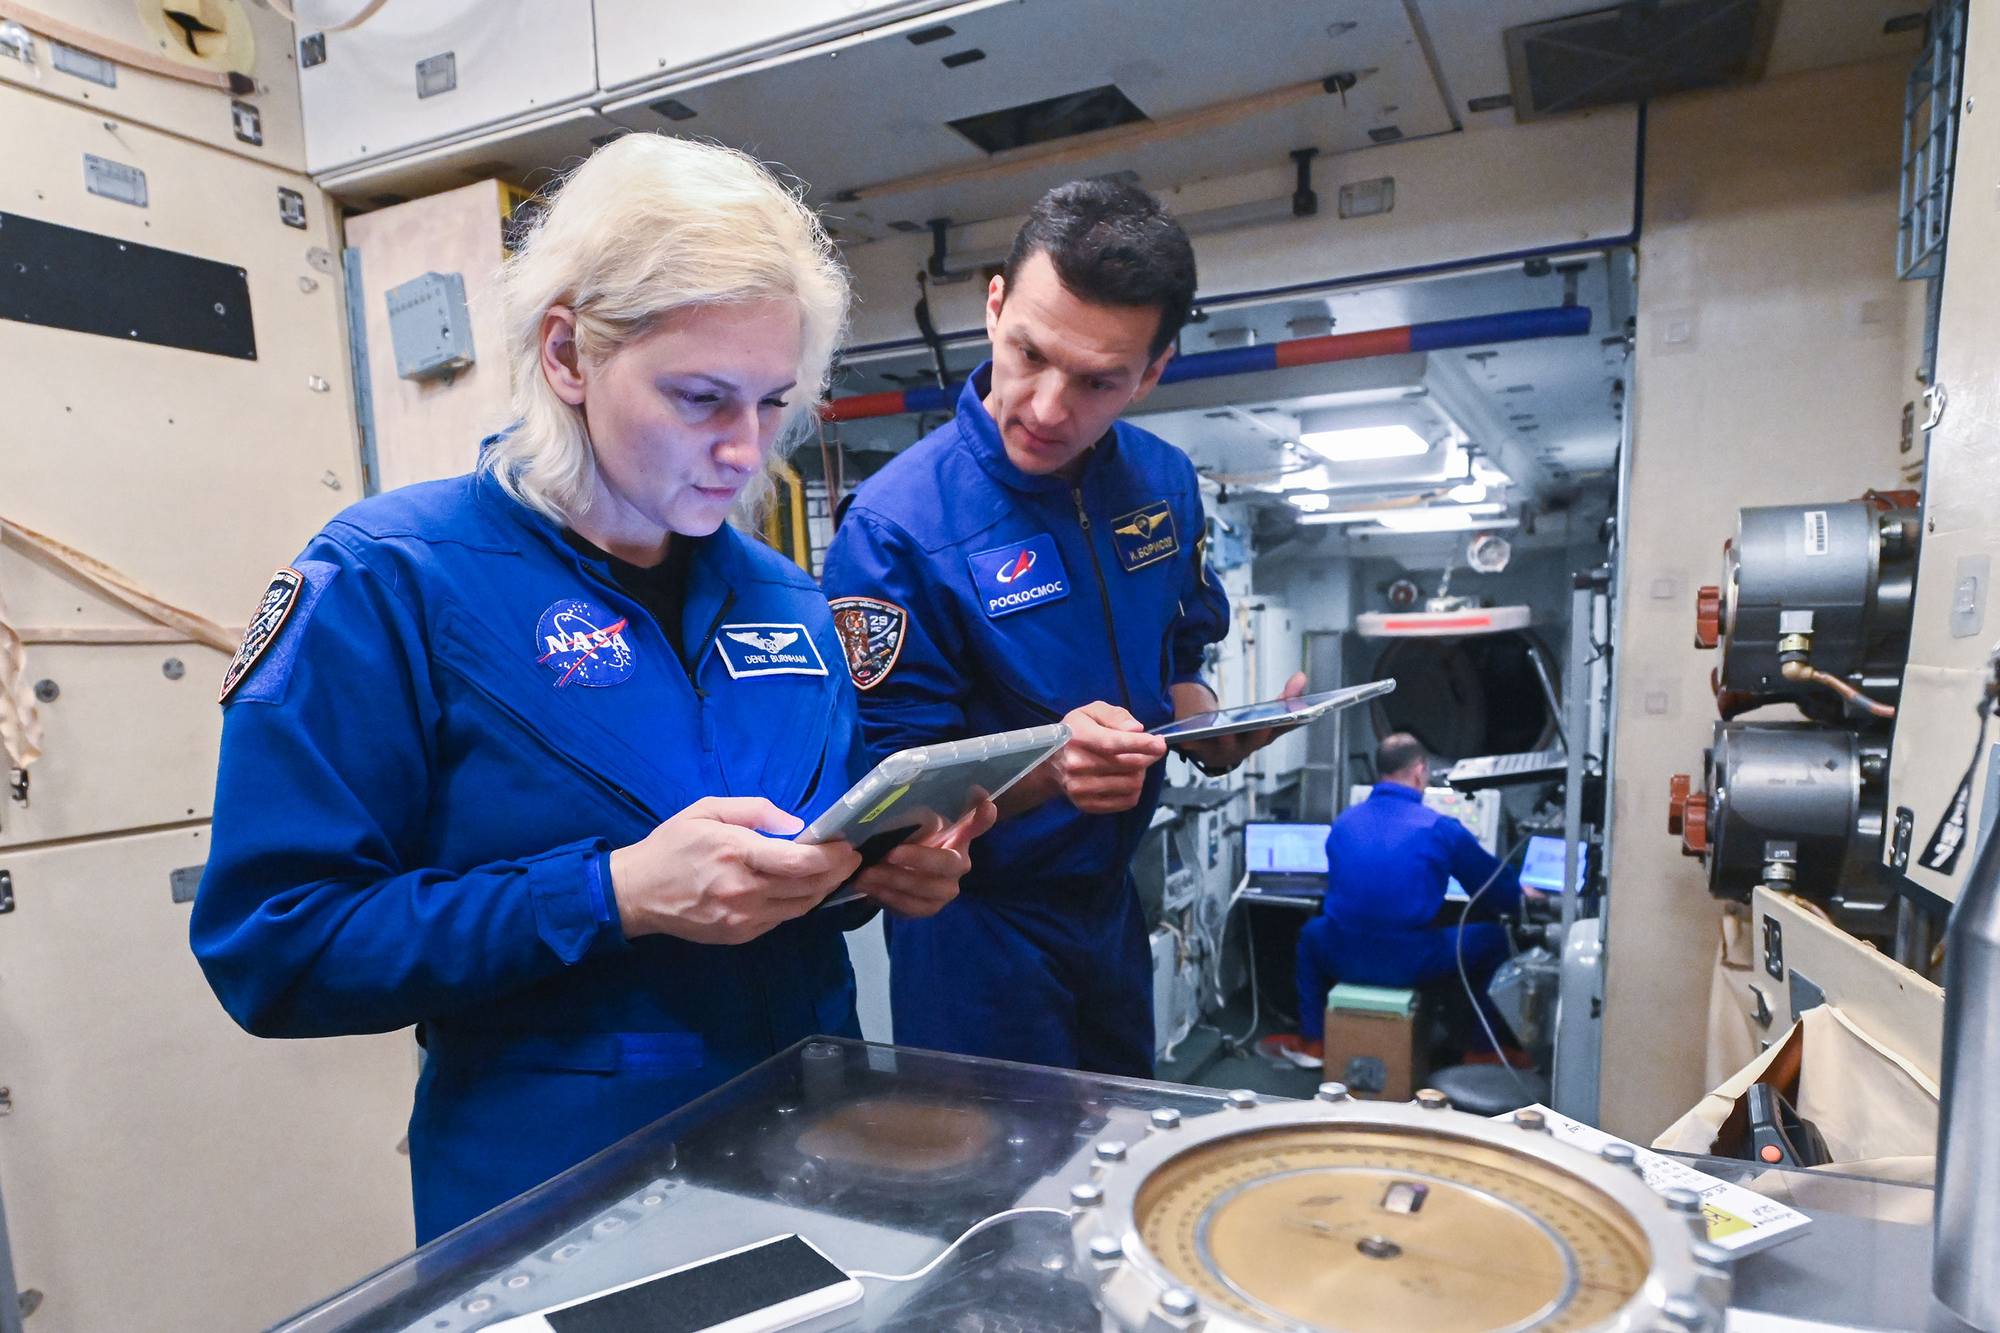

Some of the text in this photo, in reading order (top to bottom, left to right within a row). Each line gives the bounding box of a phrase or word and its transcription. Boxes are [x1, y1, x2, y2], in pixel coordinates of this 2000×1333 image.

[989, 580, 1063, 611] РОСКОСМОС
[869, 615, 888, 626] 29
[544, 631, 631, 655] NASA
